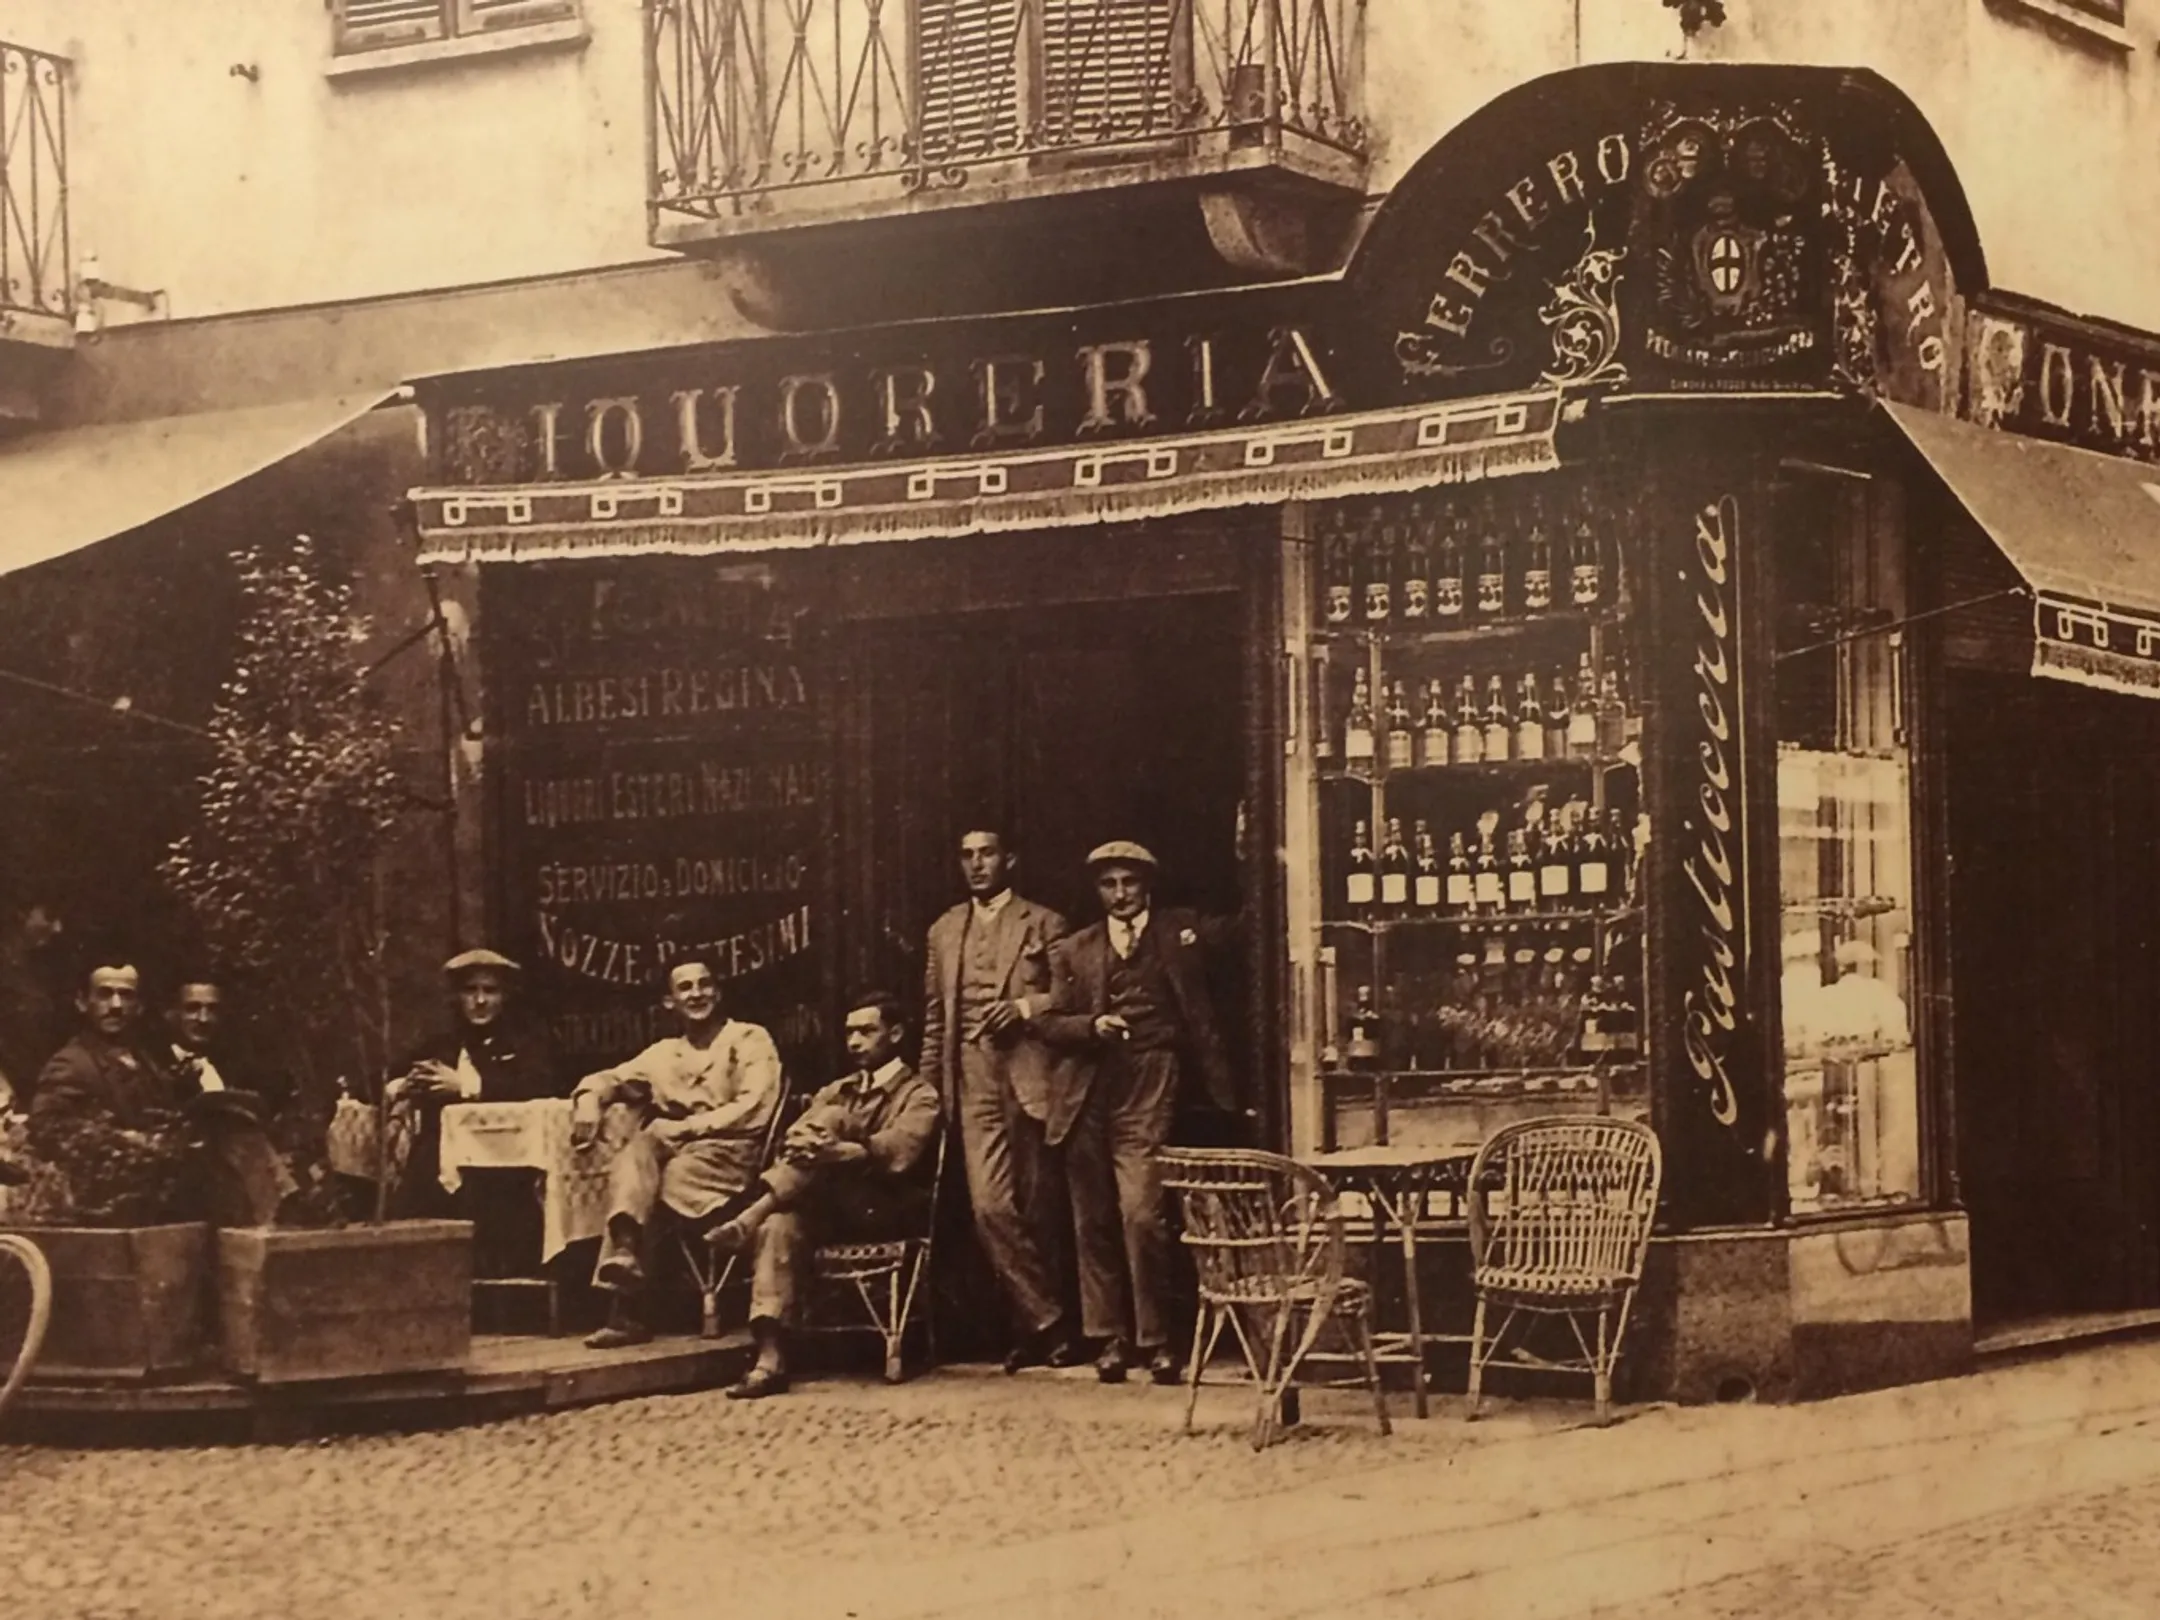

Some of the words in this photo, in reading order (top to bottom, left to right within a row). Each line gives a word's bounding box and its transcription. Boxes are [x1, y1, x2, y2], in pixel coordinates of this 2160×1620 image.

[1679, 494, 1749, 1126] Pasticceria
[537, 862, 659, 905] SERVIZIO
[537, 910, 645, 986] NOZZE
